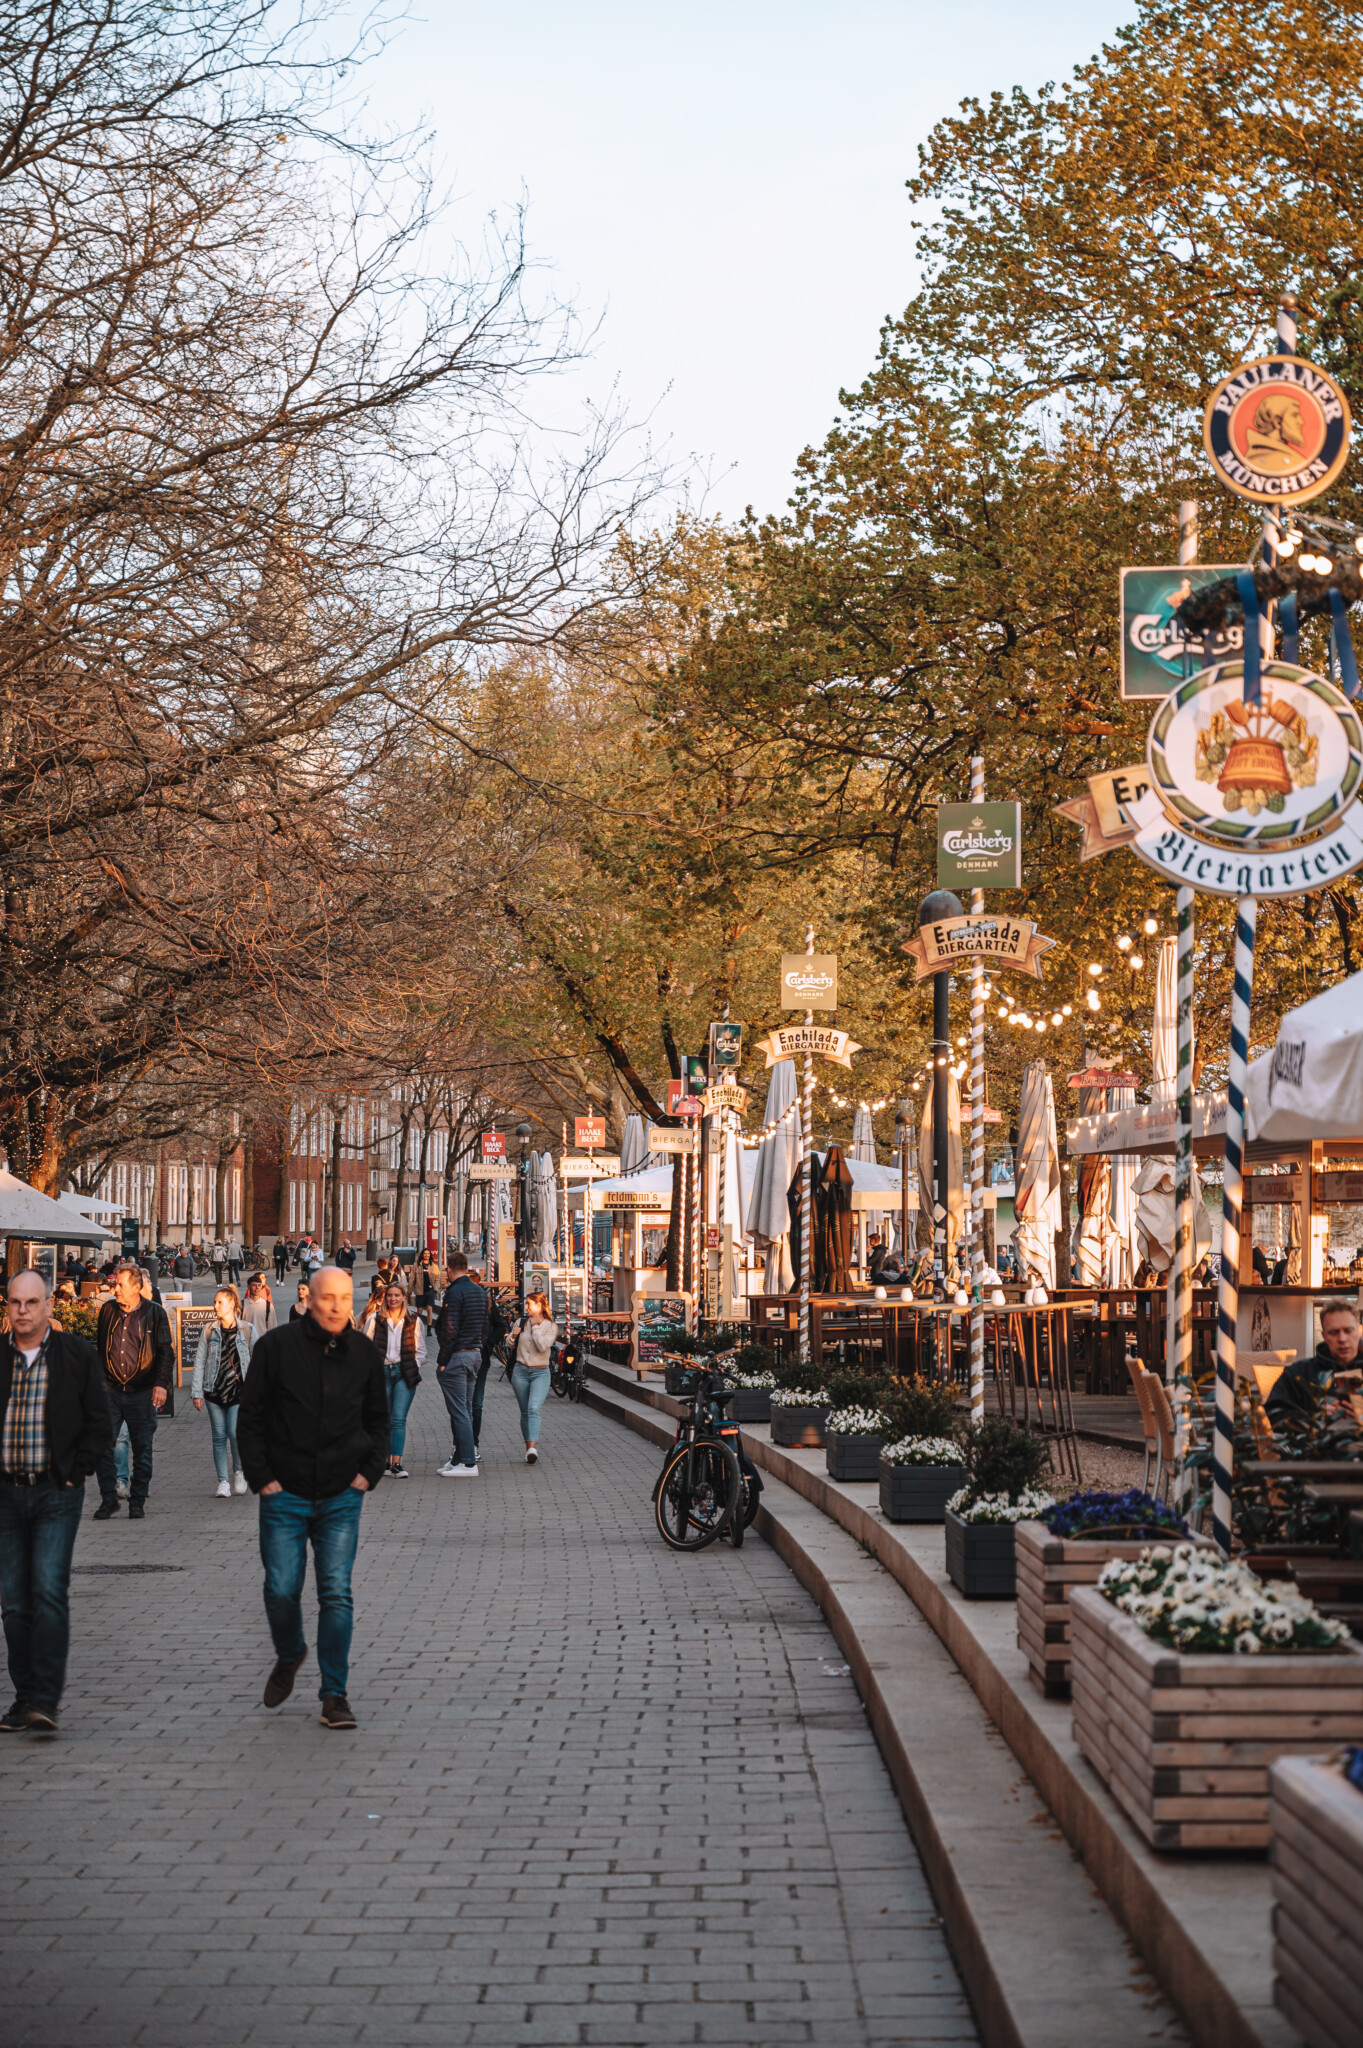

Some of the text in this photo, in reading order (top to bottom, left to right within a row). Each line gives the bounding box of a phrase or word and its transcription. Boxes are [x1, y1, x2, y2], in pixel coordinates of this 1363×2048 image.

[1214, 362, 1343, 423] PAULANER
[1129, 614, 1245, 655] Carlg
[943, 830, 1013, 857] Carlsberg
[956, 860, 999, 869] DENMARK
[1156, 830, 1352, 895] Biergarten
[937, 940, 1018, 956] BIERGARTEN
[785, 972, 833, 990] Carlsberg
[779, 1029, 839, 1045] Enchilada
[781, 1041, 838, 1052] BIERGARTEN
[1080, 1074, 1138, 1087] RED ROCK
[711, 1087, 743, 1099] Enchilada
[653, 1136, 717, 1145] BIERGAN
